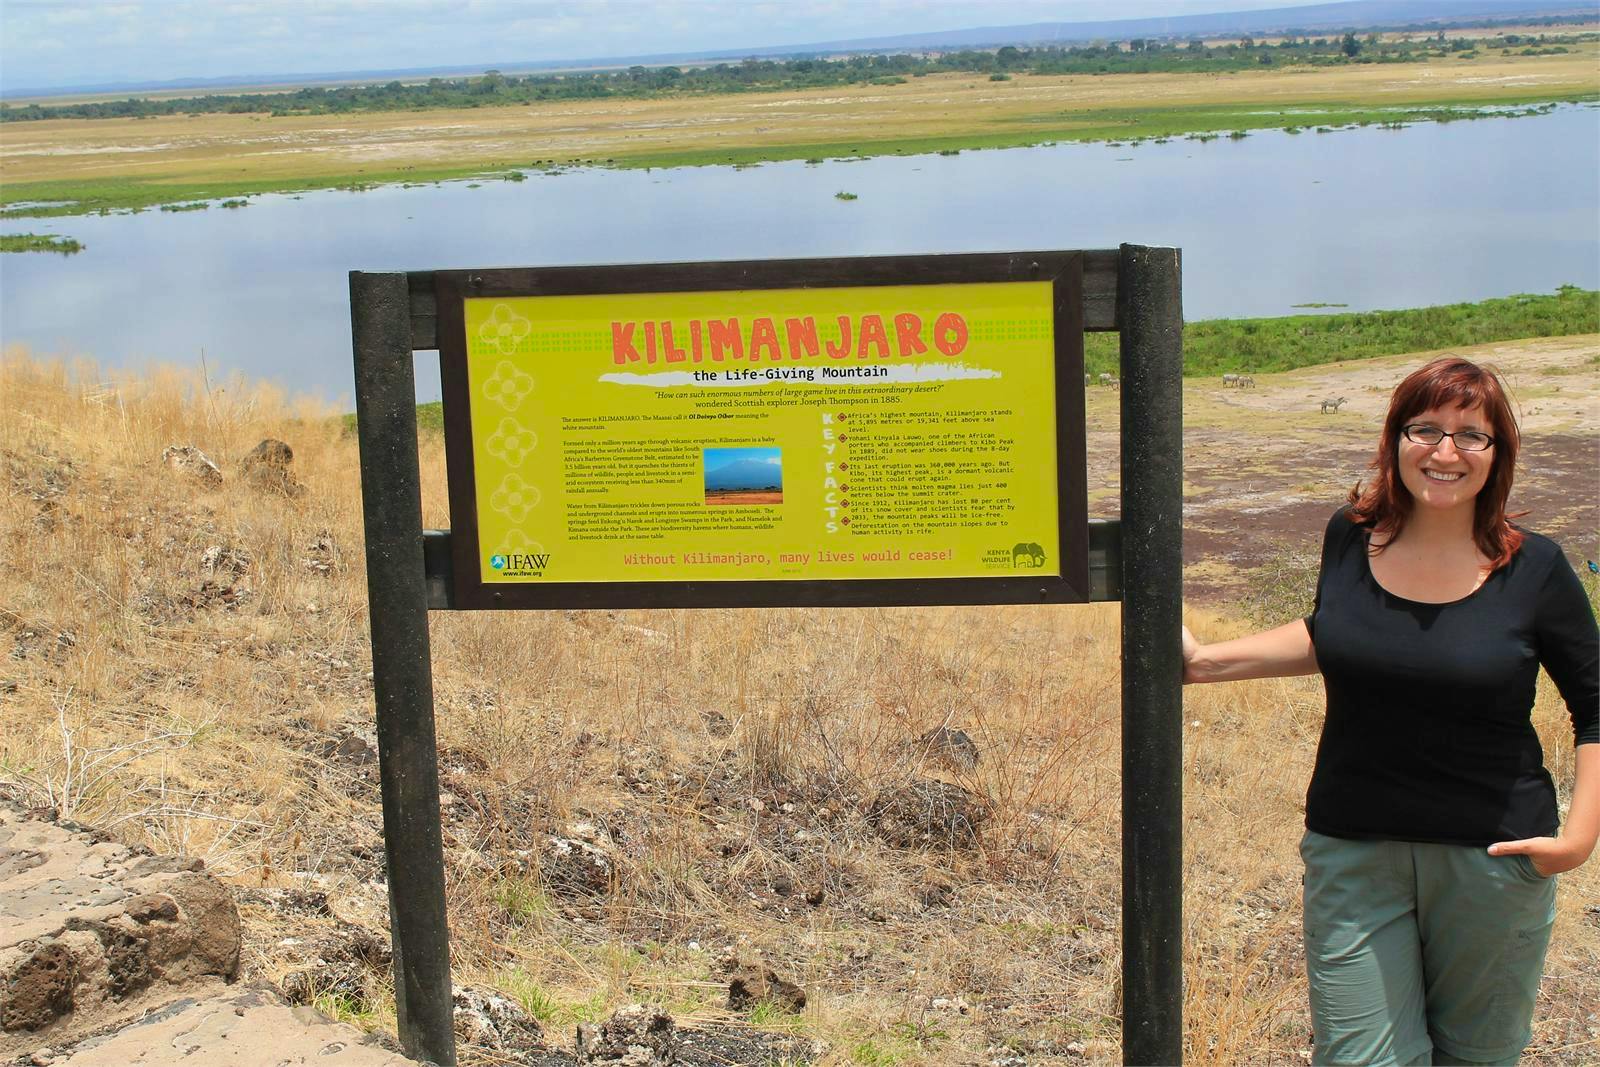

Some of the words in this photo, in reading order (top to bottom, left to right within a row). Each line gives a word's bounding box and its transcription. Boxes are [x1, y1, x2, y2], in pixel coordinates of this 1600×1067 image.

[611, 312, 969, 364] KILIMANJARO
[694, 369, 717, 381] the
[726, 367, 814, 383] Life-Giving
[822, 365, 888, 378] Mountain
[689, 390, 706, 398] such
[743, 389, 774, 397] numbers
[775, 388, 784, 396] of
[784, 388, 803, 398] large
[824, 387, 838, 395] live
[862, 385, 914, 396] extraordinary
[695, 400, 733, 408] wondered
[734, 399, 765, 407] Scottish
[767, 398, 798, 408] explorer
[800, 398, 827, 408] Joseph
[828, 397, 869, 407] Thompson
[879, 396, 902, 404] 1885.
[946, 410, 987, 418] Kilimanjaro
[506, 554, 550, 569] IFAW
[624, 553, 675, 564] Without
[683, 551, 770, 566] Kilimanjaro,
[779, 554, 810, 565] many
[818, 550, 854, 562] lives
[862, 549, 901, 561] would
[909, 549, 952, 561] cease!
